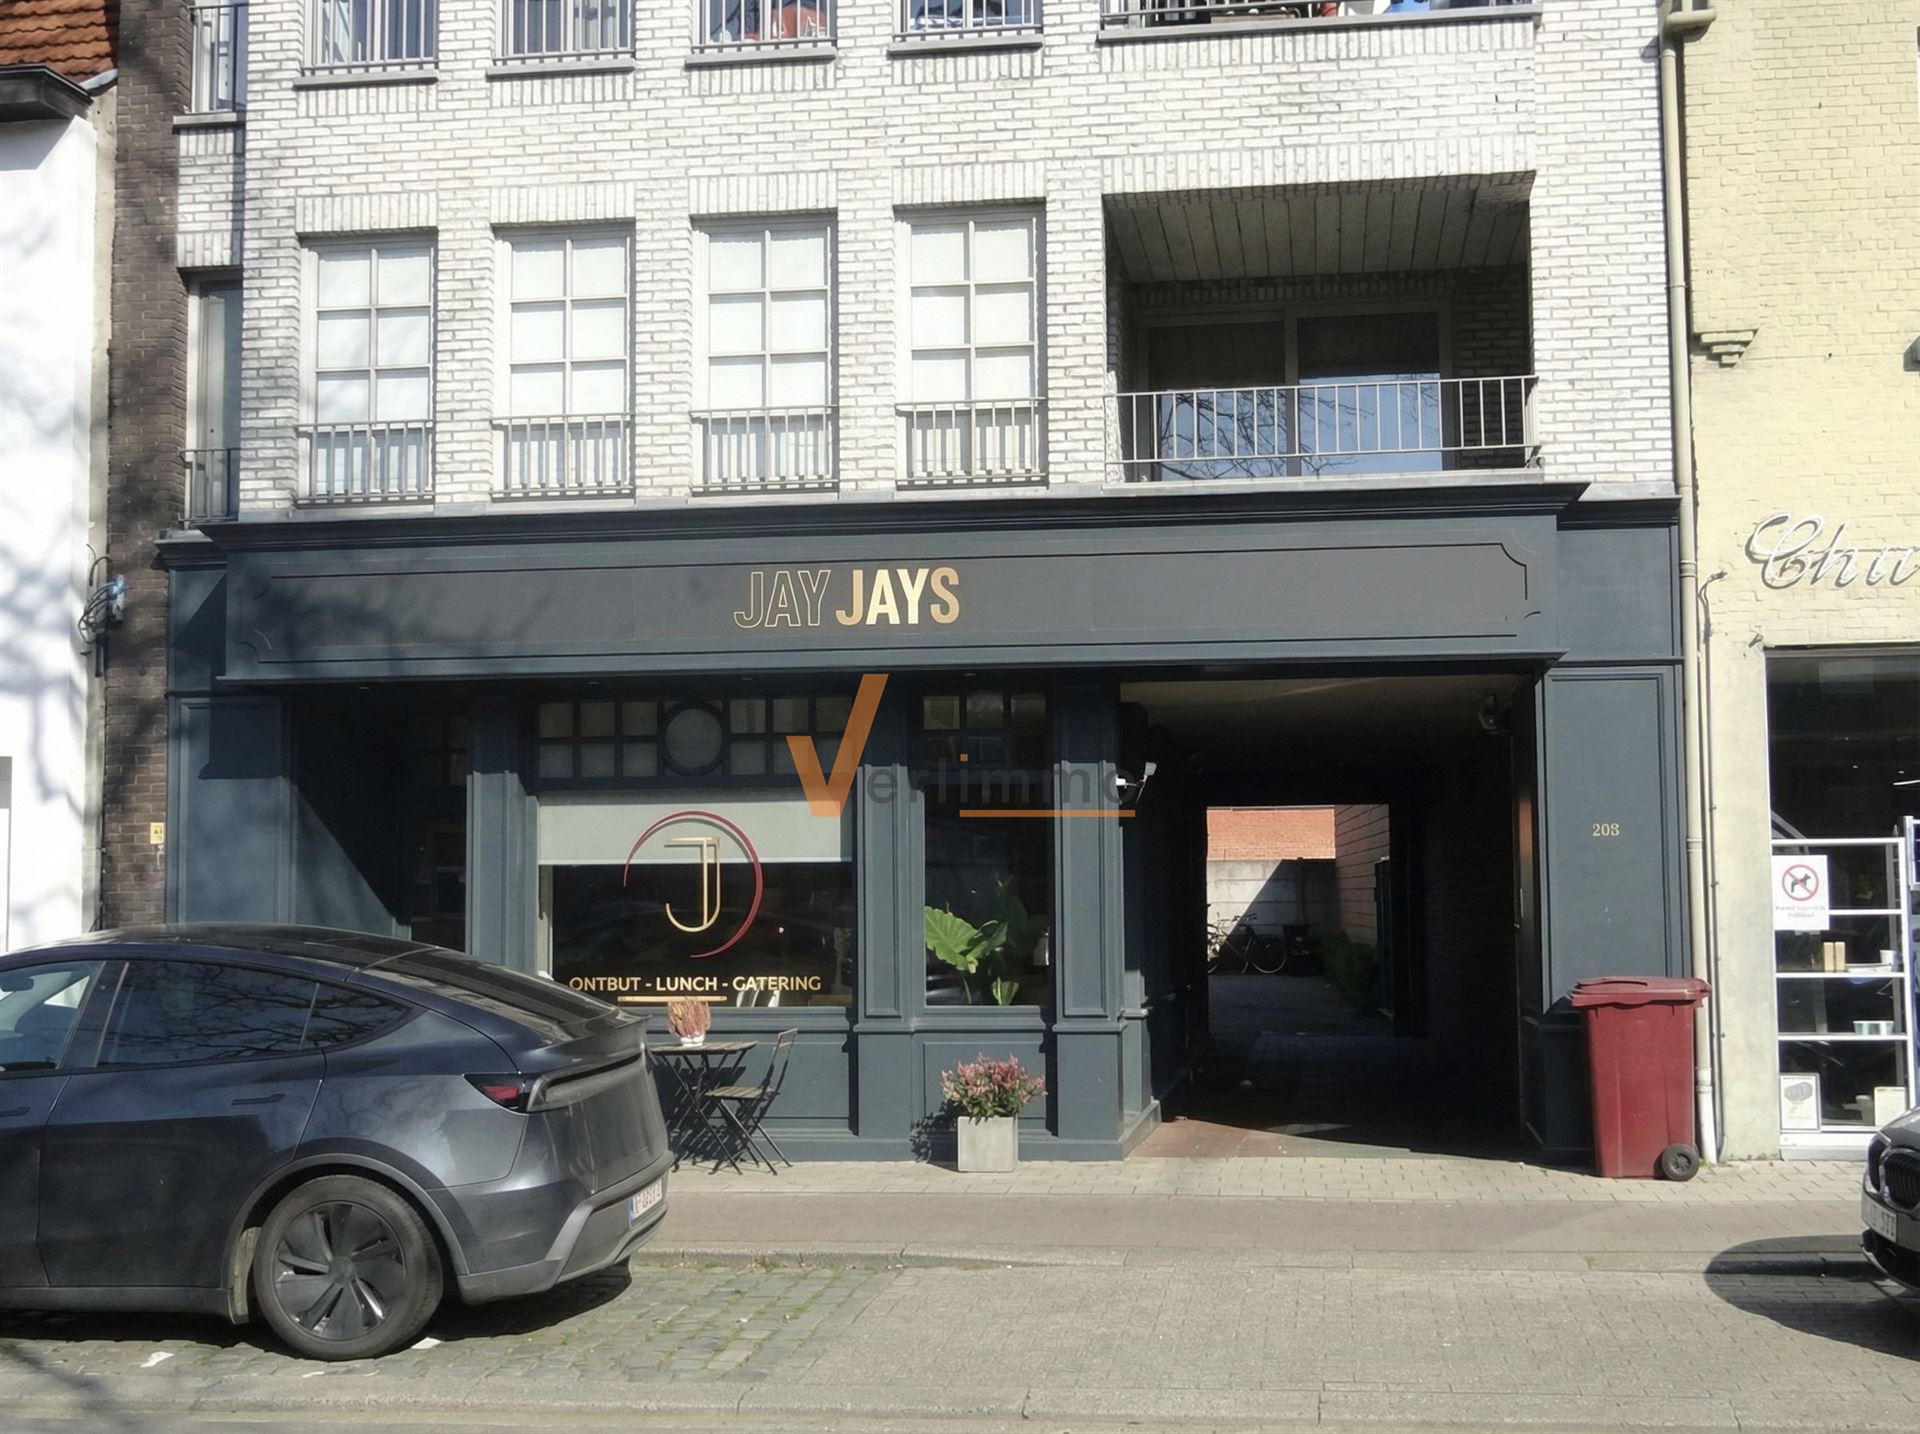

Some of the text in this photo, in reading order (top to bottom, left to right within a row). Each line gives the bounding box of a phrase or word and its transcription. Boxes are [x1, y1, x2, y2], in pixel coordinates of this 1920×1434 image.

[733, 566, 960, 629] JAY JAYS
[1592, 823, 1620, 837] 208
[656, 976, 717, 991] LUNCH
